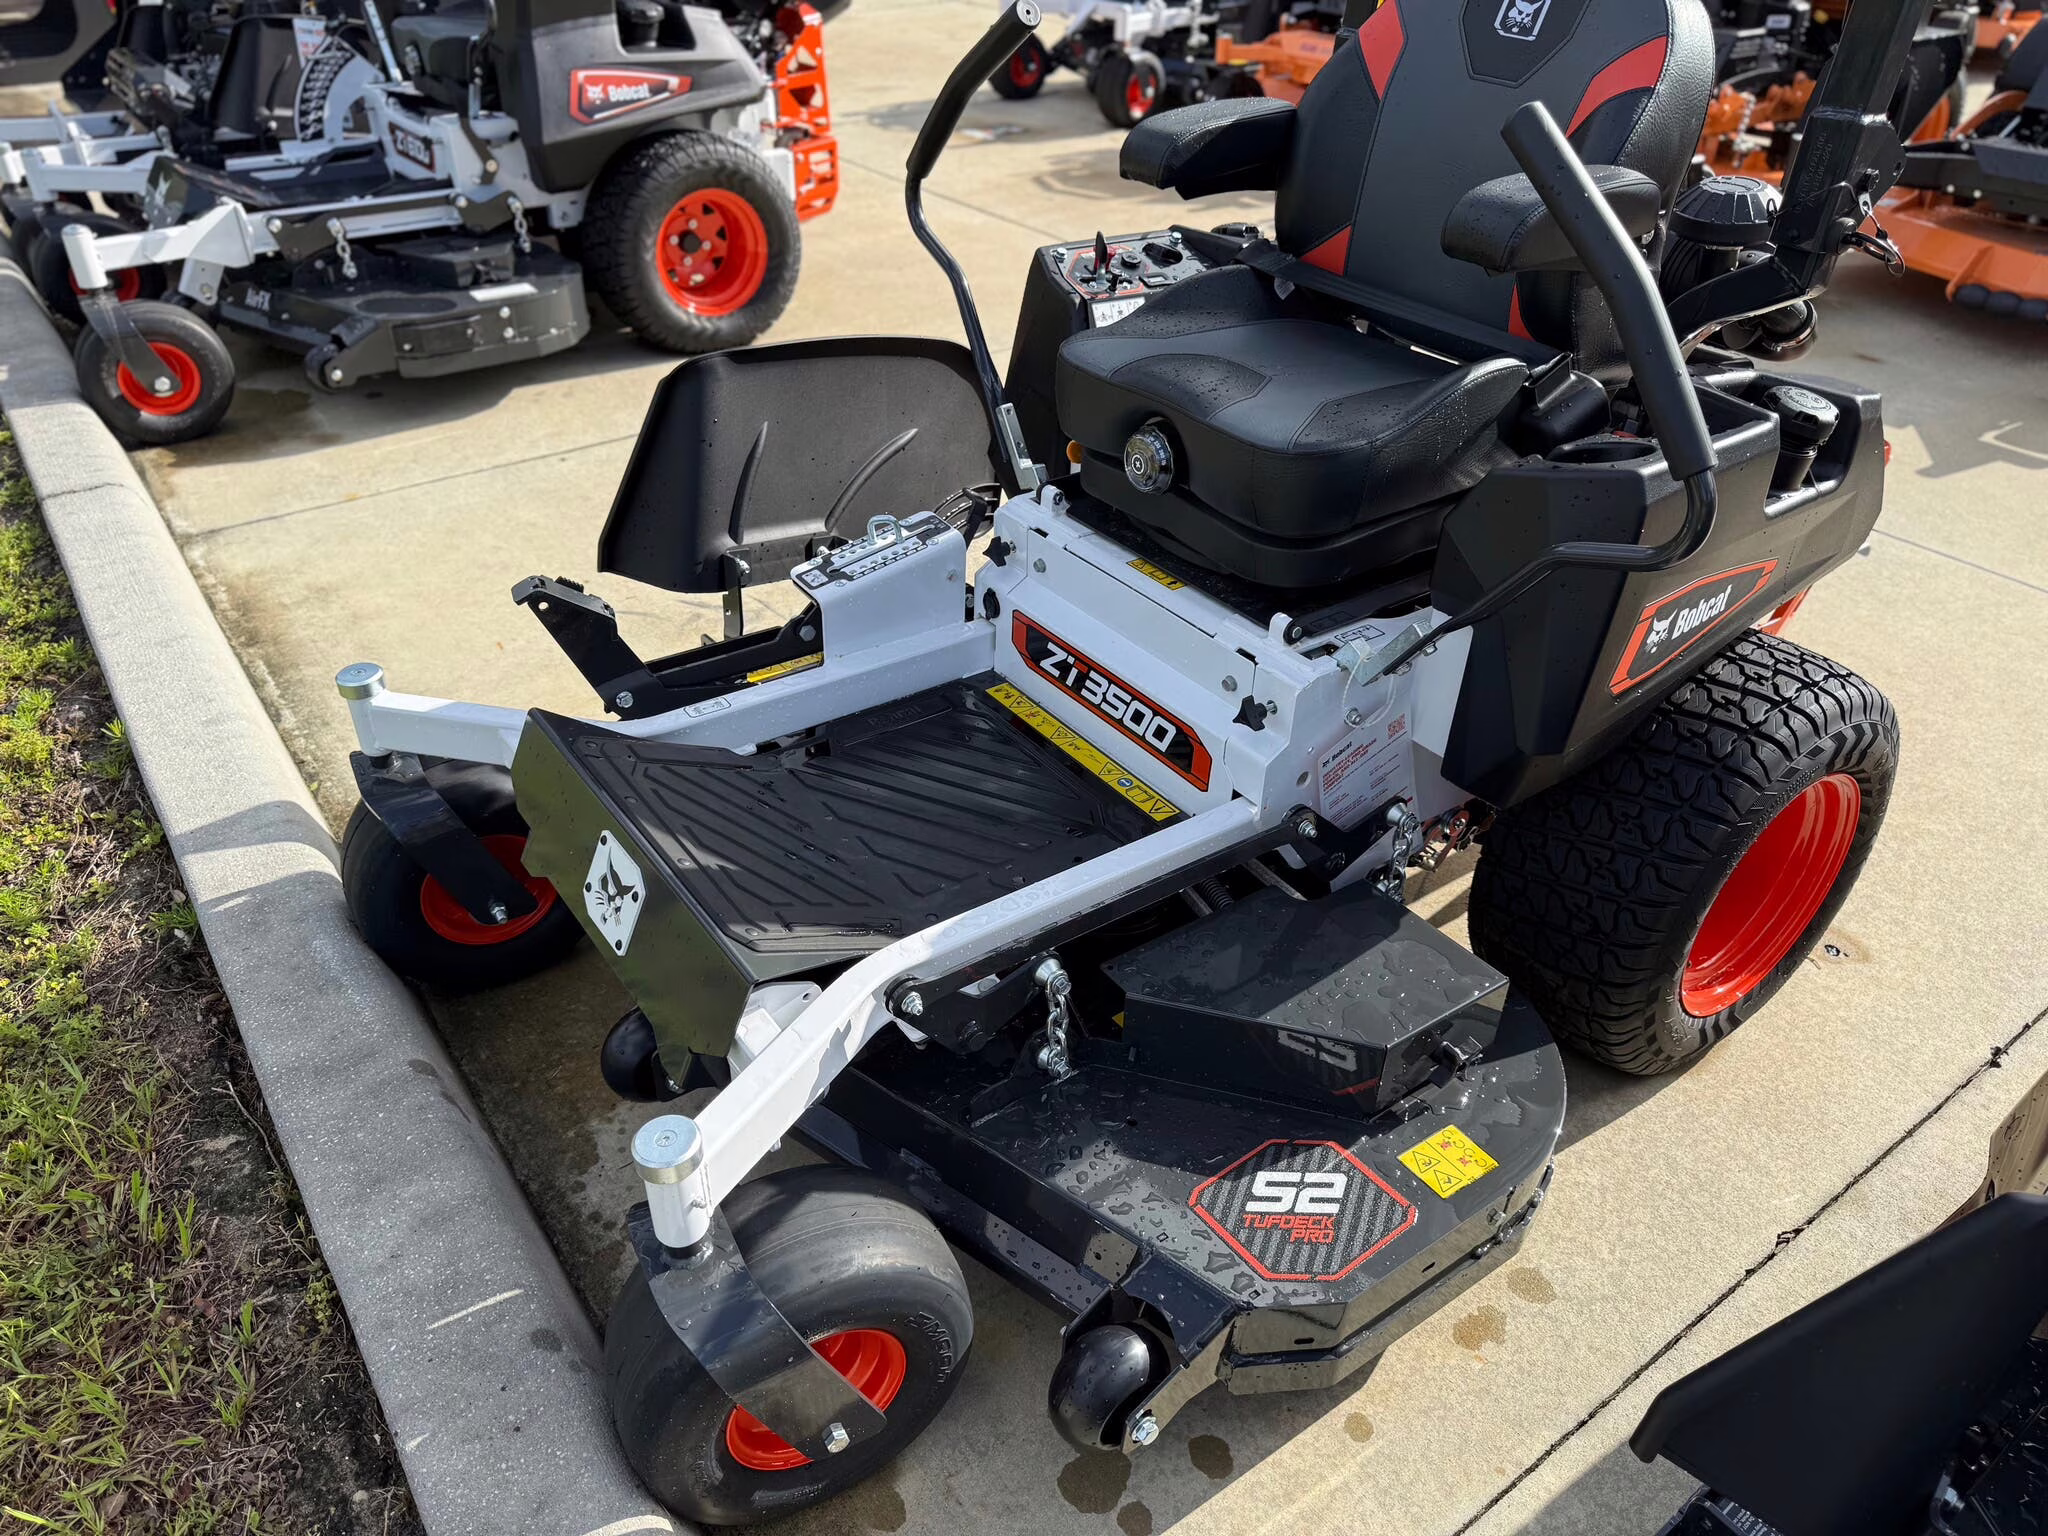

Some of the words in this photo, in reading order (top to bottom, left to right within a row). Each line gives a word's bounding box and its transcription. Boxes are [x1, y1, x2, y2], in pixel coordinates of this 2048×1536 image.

[608, 83, 651, 102] Bobcat
[1671, 584, 1732, 639] Bobcat
[1040, 642, 1176, 752] ZT3500
[1332, 741, 1352, 761] Bobcat
[1245, 1171, 1347, 1214] 52
[1242, 1214, 1336, 1230] TUFDECK
[1289, 1228, 1335, 1243] PRO
